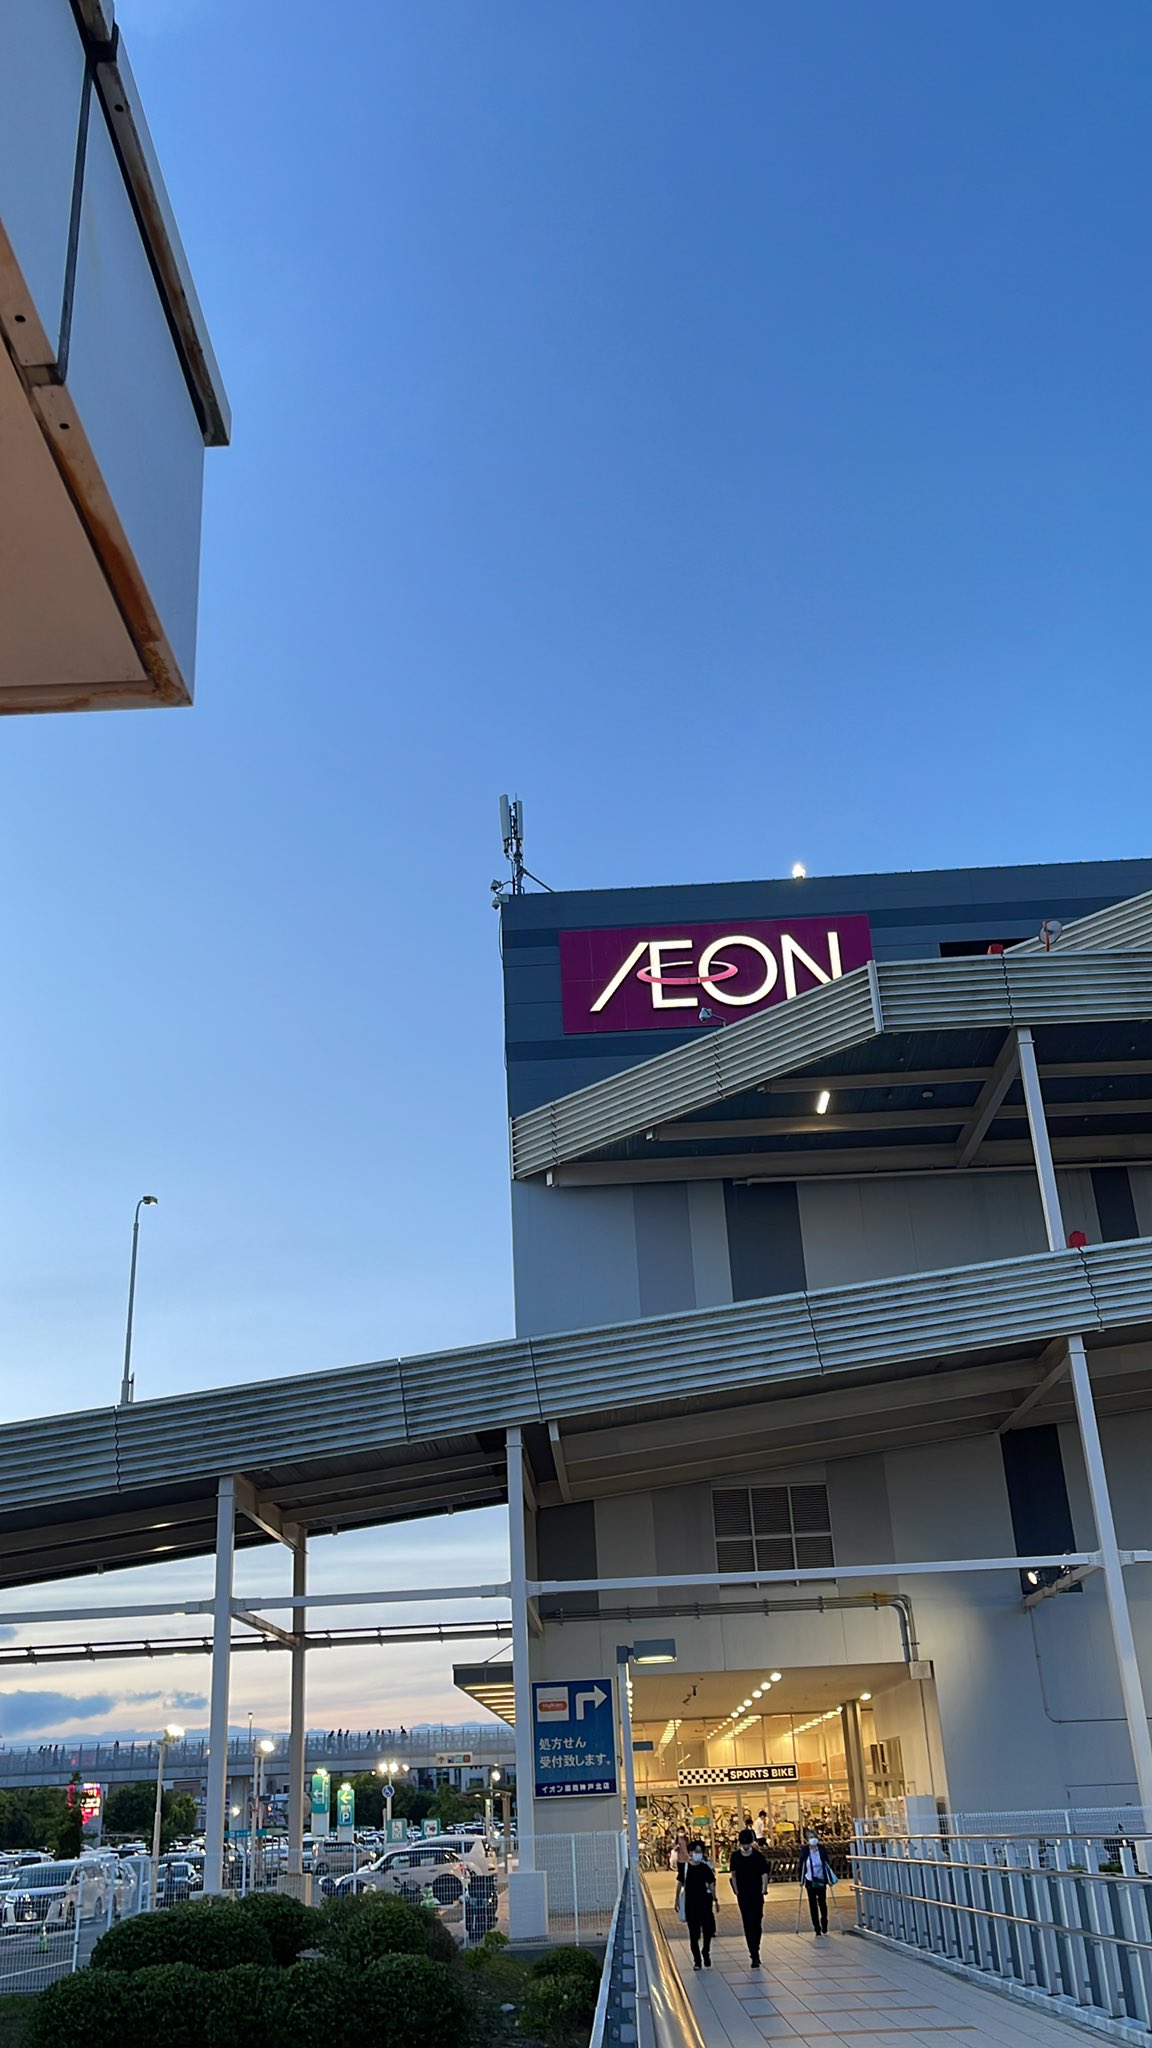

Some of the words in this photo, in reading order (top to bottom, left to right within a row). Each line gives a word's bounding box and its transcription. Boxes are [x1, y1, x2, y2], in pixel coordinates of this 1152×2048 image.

[539, 1737, 586, 1751] 処方せん
[540, 1753, 611, 1769] 受付致します。
[730, 1769, 770, 1780] SPORTS
[771, 1767, 795, 1778] BIKE
[342, 1812, 350, 1823] P
